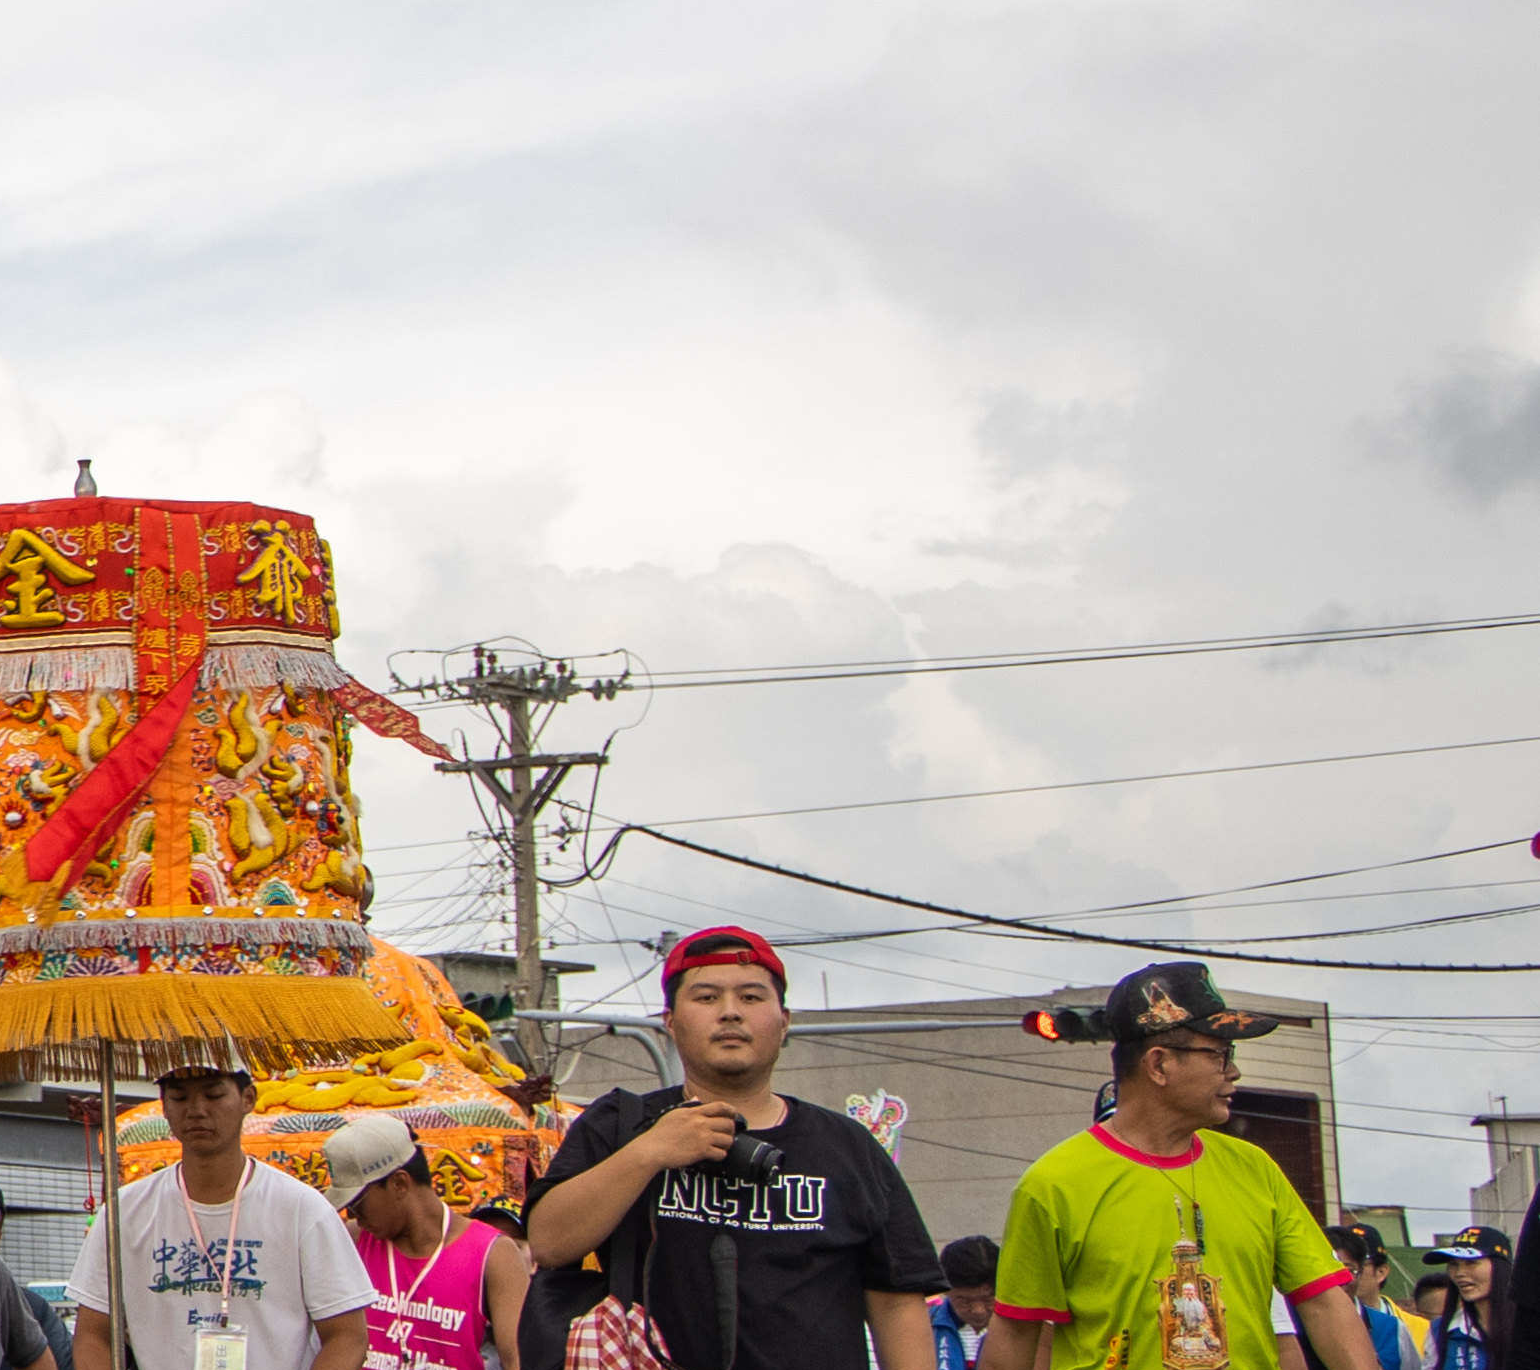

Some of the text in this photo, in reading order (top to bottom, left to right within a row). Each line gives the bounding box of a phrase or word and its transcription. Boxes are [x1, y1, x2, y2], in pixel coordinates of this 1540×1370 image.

[659, 1169, 826, 1222] NCTU
[658, 1209, 705, 1223] NATIONAL
[742, 1221, 769, 1231] TUNG
[772, 1223, 825, 1231] UNIVERSITY
[386, 1319, 414, 1344] 47
